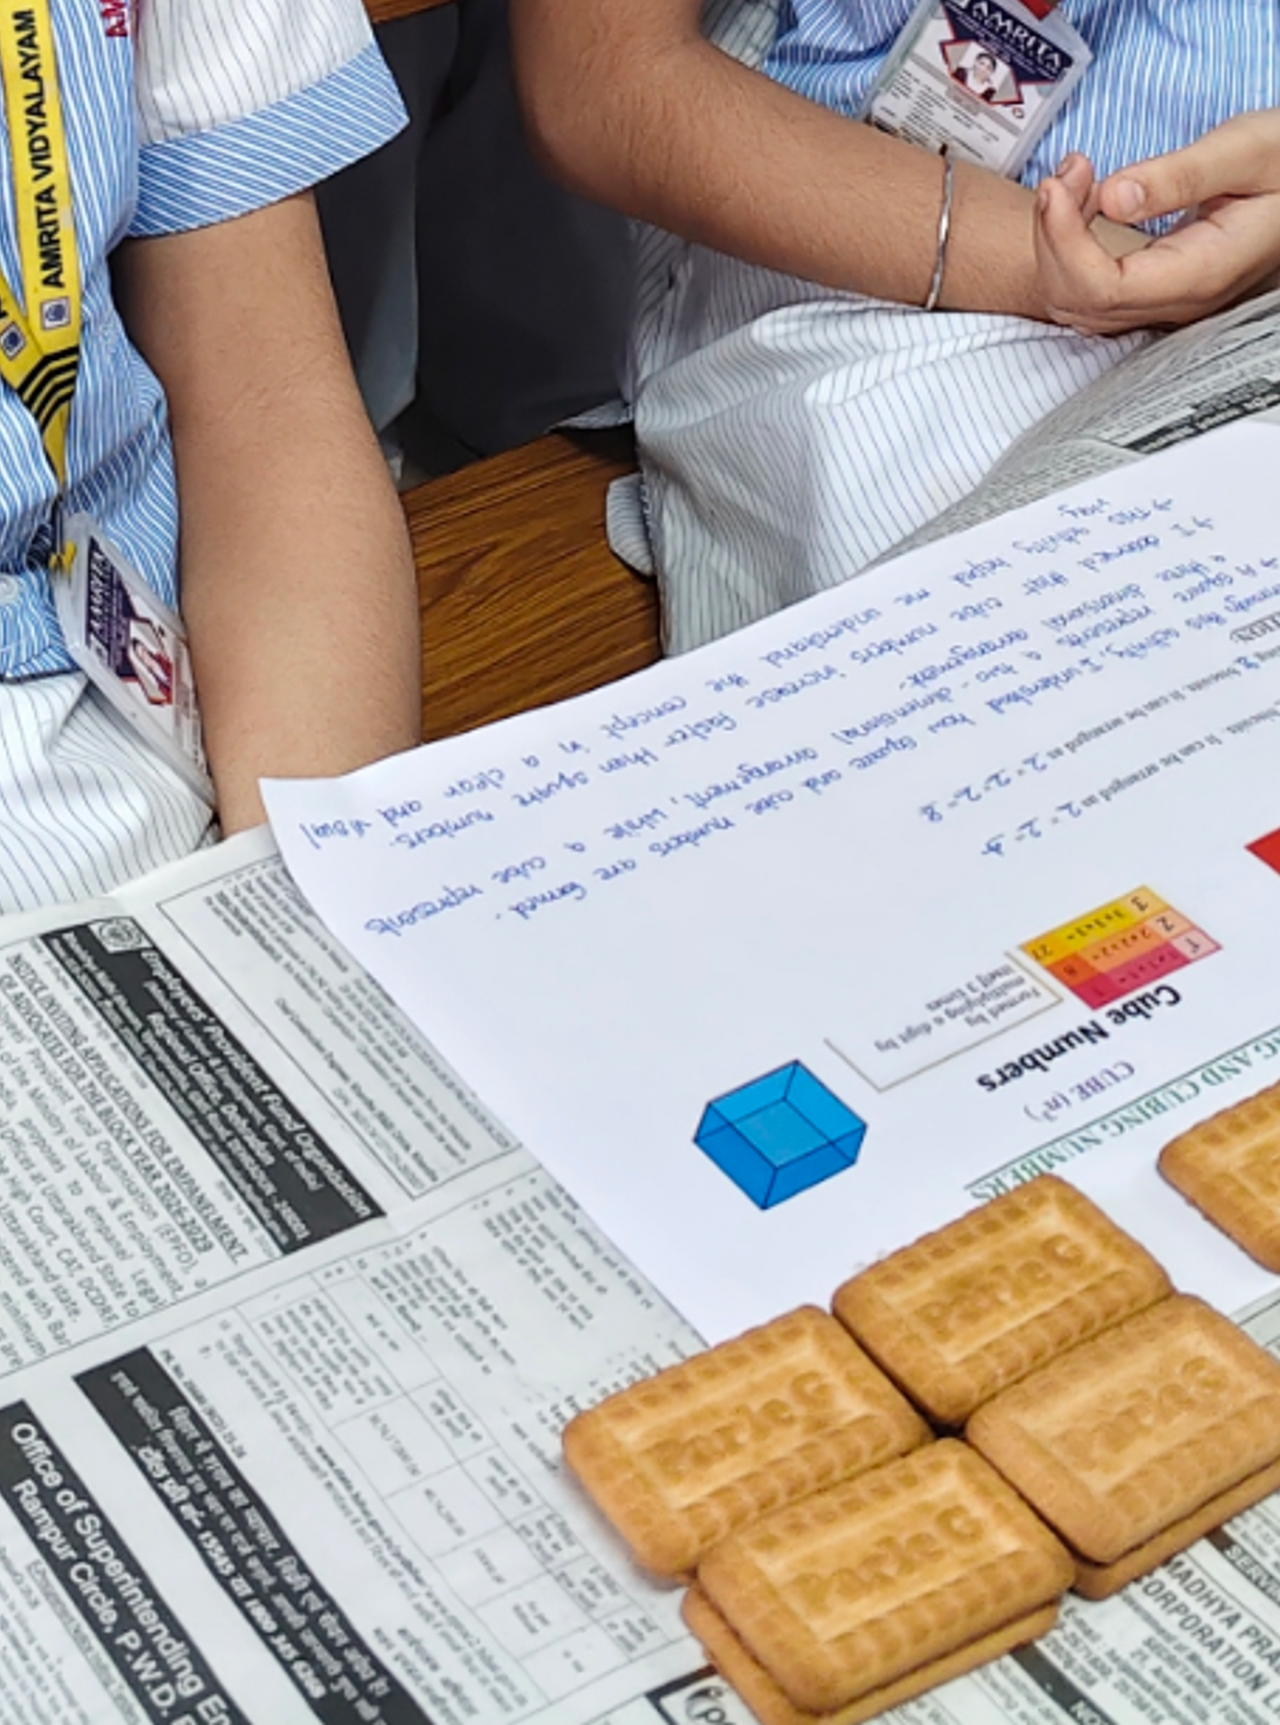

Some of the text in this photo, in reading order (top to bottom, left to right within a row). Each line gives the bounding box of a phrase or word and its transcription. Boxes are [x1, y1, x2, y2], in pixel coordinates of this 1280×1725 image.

[972, 0, 1063, 69] AMRITA
[10, 7, 70, 292] AMRITA VIDYALAYAM
[951, 555, 1012, 590] helped
[1171, 570, 1235, 605] square
[948, 595, 1004, 623] cube
[760, 606, 881, 670] understand
[848, 621, 939, 667] numbers
[703, 671, 750, 694] the
[744, 663, 839, 710] increase
[599, 694, 688, 742] concept
[665, 710, 739, 748] faster
[926, 711, 970, 735] how
[848, 734, 919, 772] square
[442, 767, 506, 800] clear
[510, 769, 590, 809] square
[800, 768, 842, 797] and
[375, 798, 423, 830] and
[744, 788, 795, 817] cube
[602, 806, 667, 841] while
[647, 815, 735, 859] numbers
[562, 840, 588, 855] a
[490, 855, 547, 886] cube
[592, 858, 637, 882] are
[974, 964, 1016, 990] itself
[924, 987, 971, 1014] times
[942, 971, 1026, 1023] multiplying
[962, 986, 1043, 1028] Formed by
[869, 1035, 899, 1056] by
[896, 1021, 934, 1046] digit
[975, 983, 1183, 1093] Cube Numbers
[1068, 1060, 1136, 1102] CUBE
[1194, 1049, 1254, 1087] AND
[198, 1021, 274, 1098] Provident
[257, 1089, 308, 1137] Fund
[289, 1130, 377, 1222] Organisation
[1094, 1076, 1202, 1138] CUBING
[963, 1127, 1101, 1209] NUMBERS
[9, 1421, 65, 1490] Office
[53, 1487, 91, 1516] of
[10, 1476, 188, 1719] Rampur Circle, P.W.D.
[57, 1512, 225, 1700] Superintending
[1164, 1557, 1244, 1631] MADHYA
